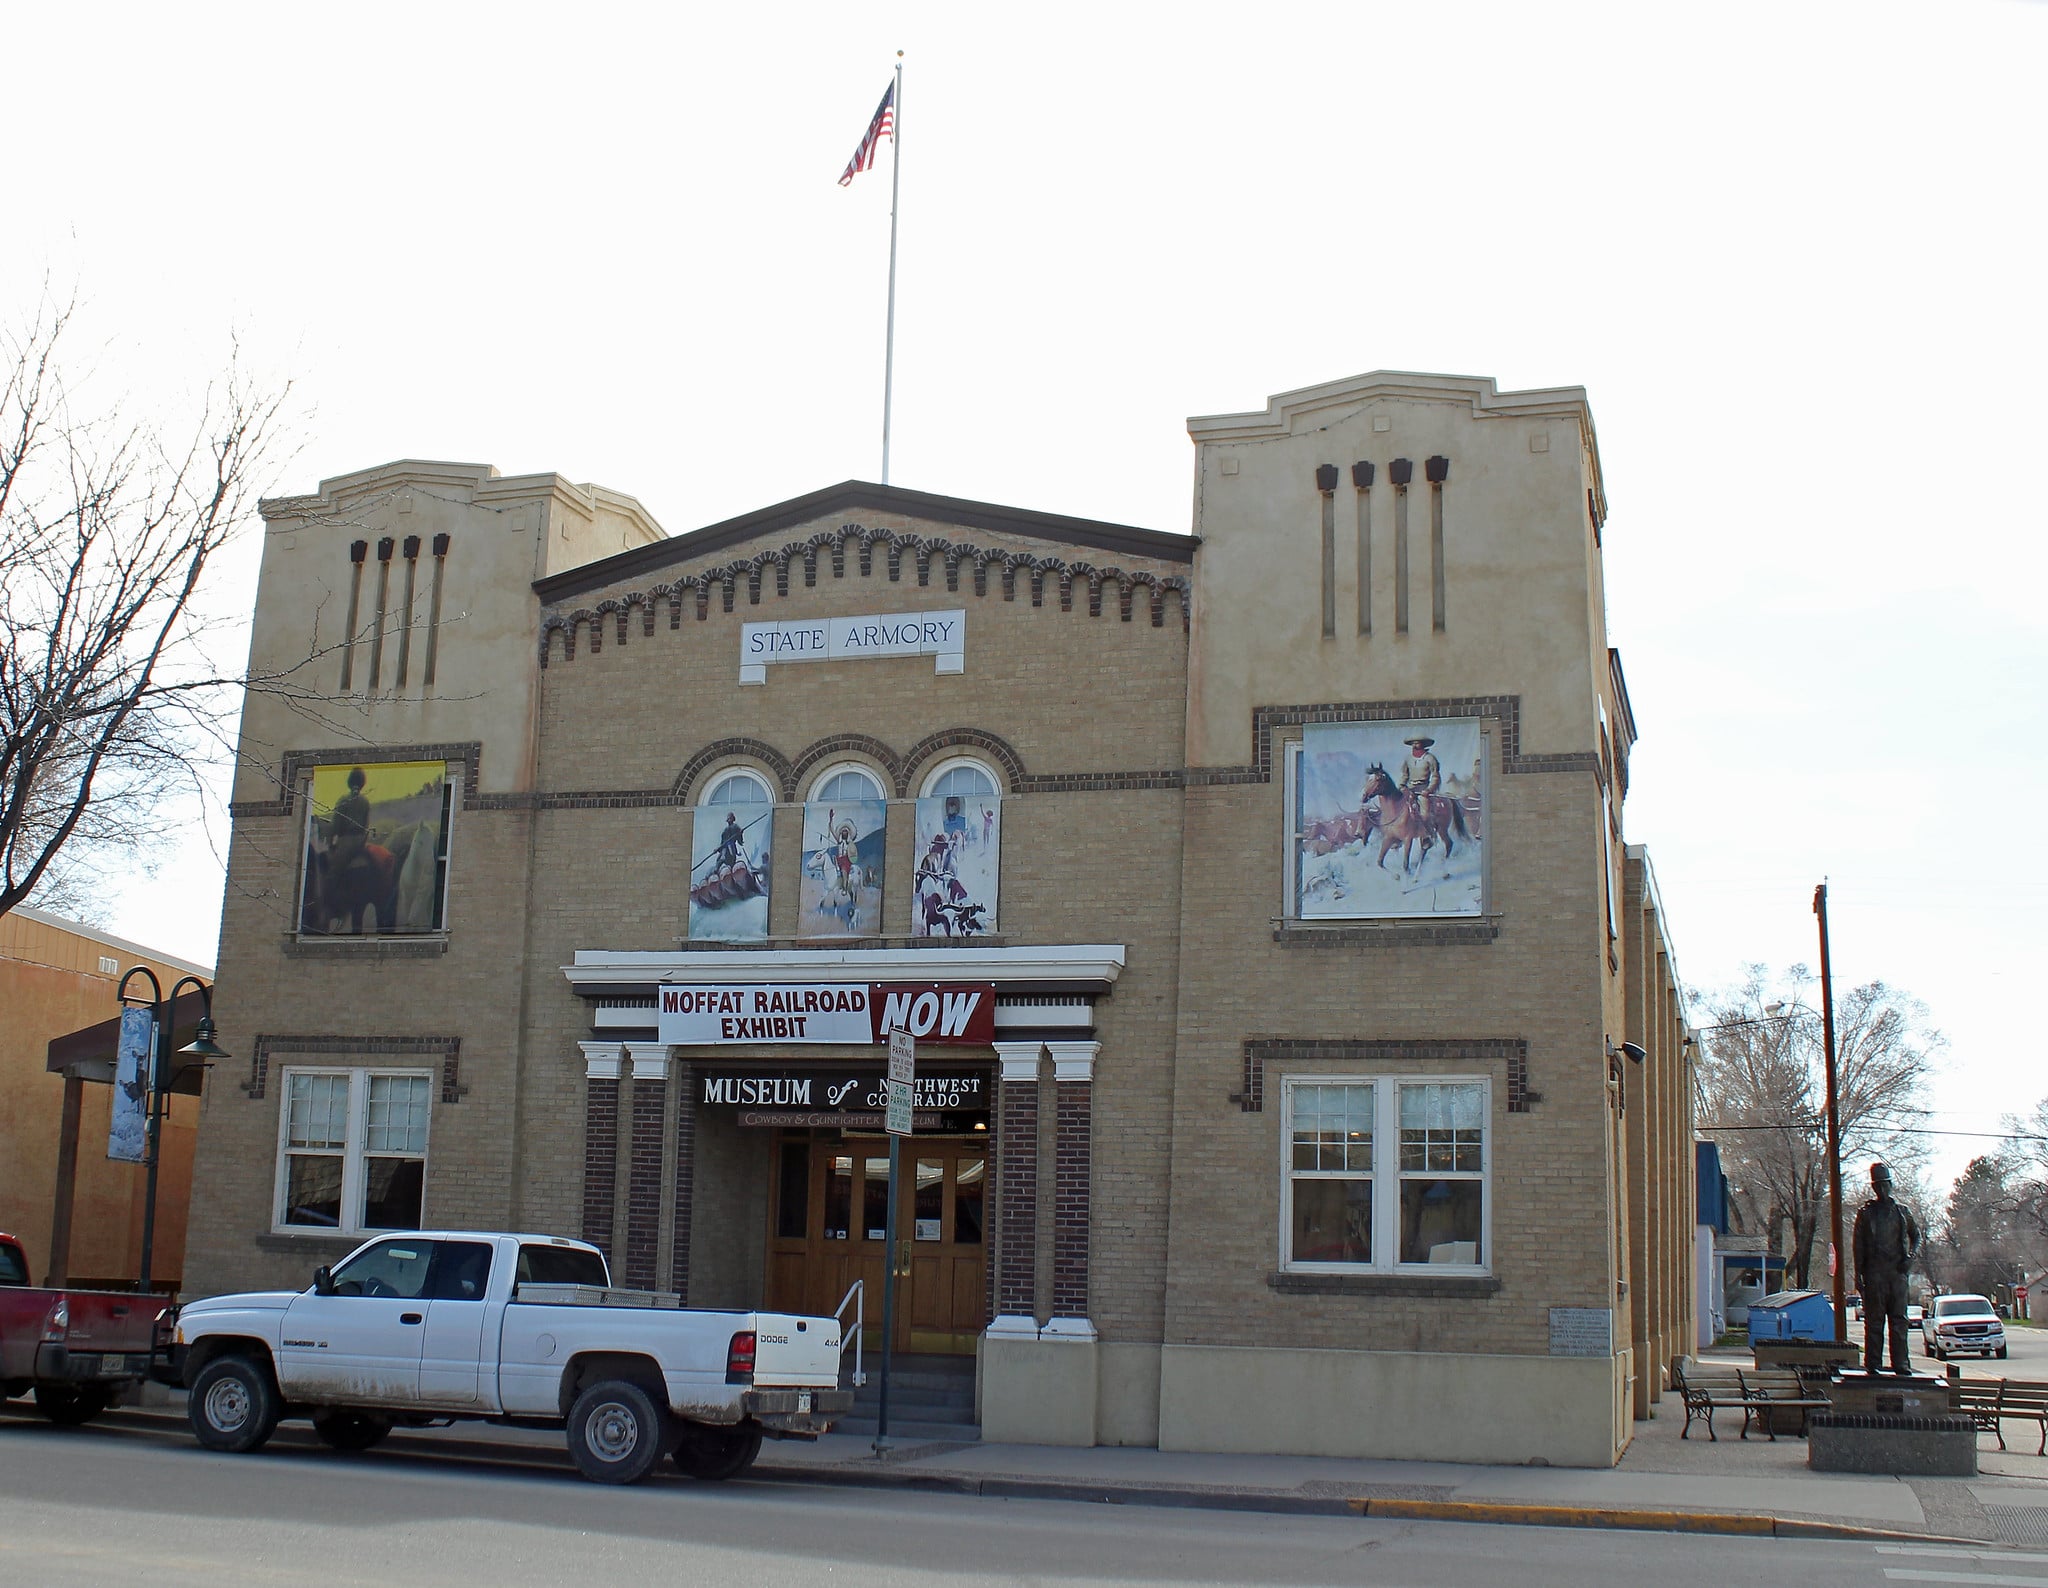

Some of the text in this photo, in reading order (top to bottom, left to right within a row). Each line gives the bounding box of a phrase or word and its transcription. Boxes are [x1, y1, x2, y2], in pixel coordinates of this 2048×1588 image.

[750, 621, 955, 653] STATE ARMORY
[663, 990, 866, 1014] MOFFAT RAILROAD
[879, 991, 982, 1037] NOW
[721, 1017, 807, 1039] EXHIBIT
[703, 1078, 859, 1106] MUSEUM of
[879, 1078, 980, 1093] NTHWEST
[866, 1092, 960, 1107] CORADO
[794, 1113, 805, 1124] &
[760, 1334, 788, 1344] DODGE
